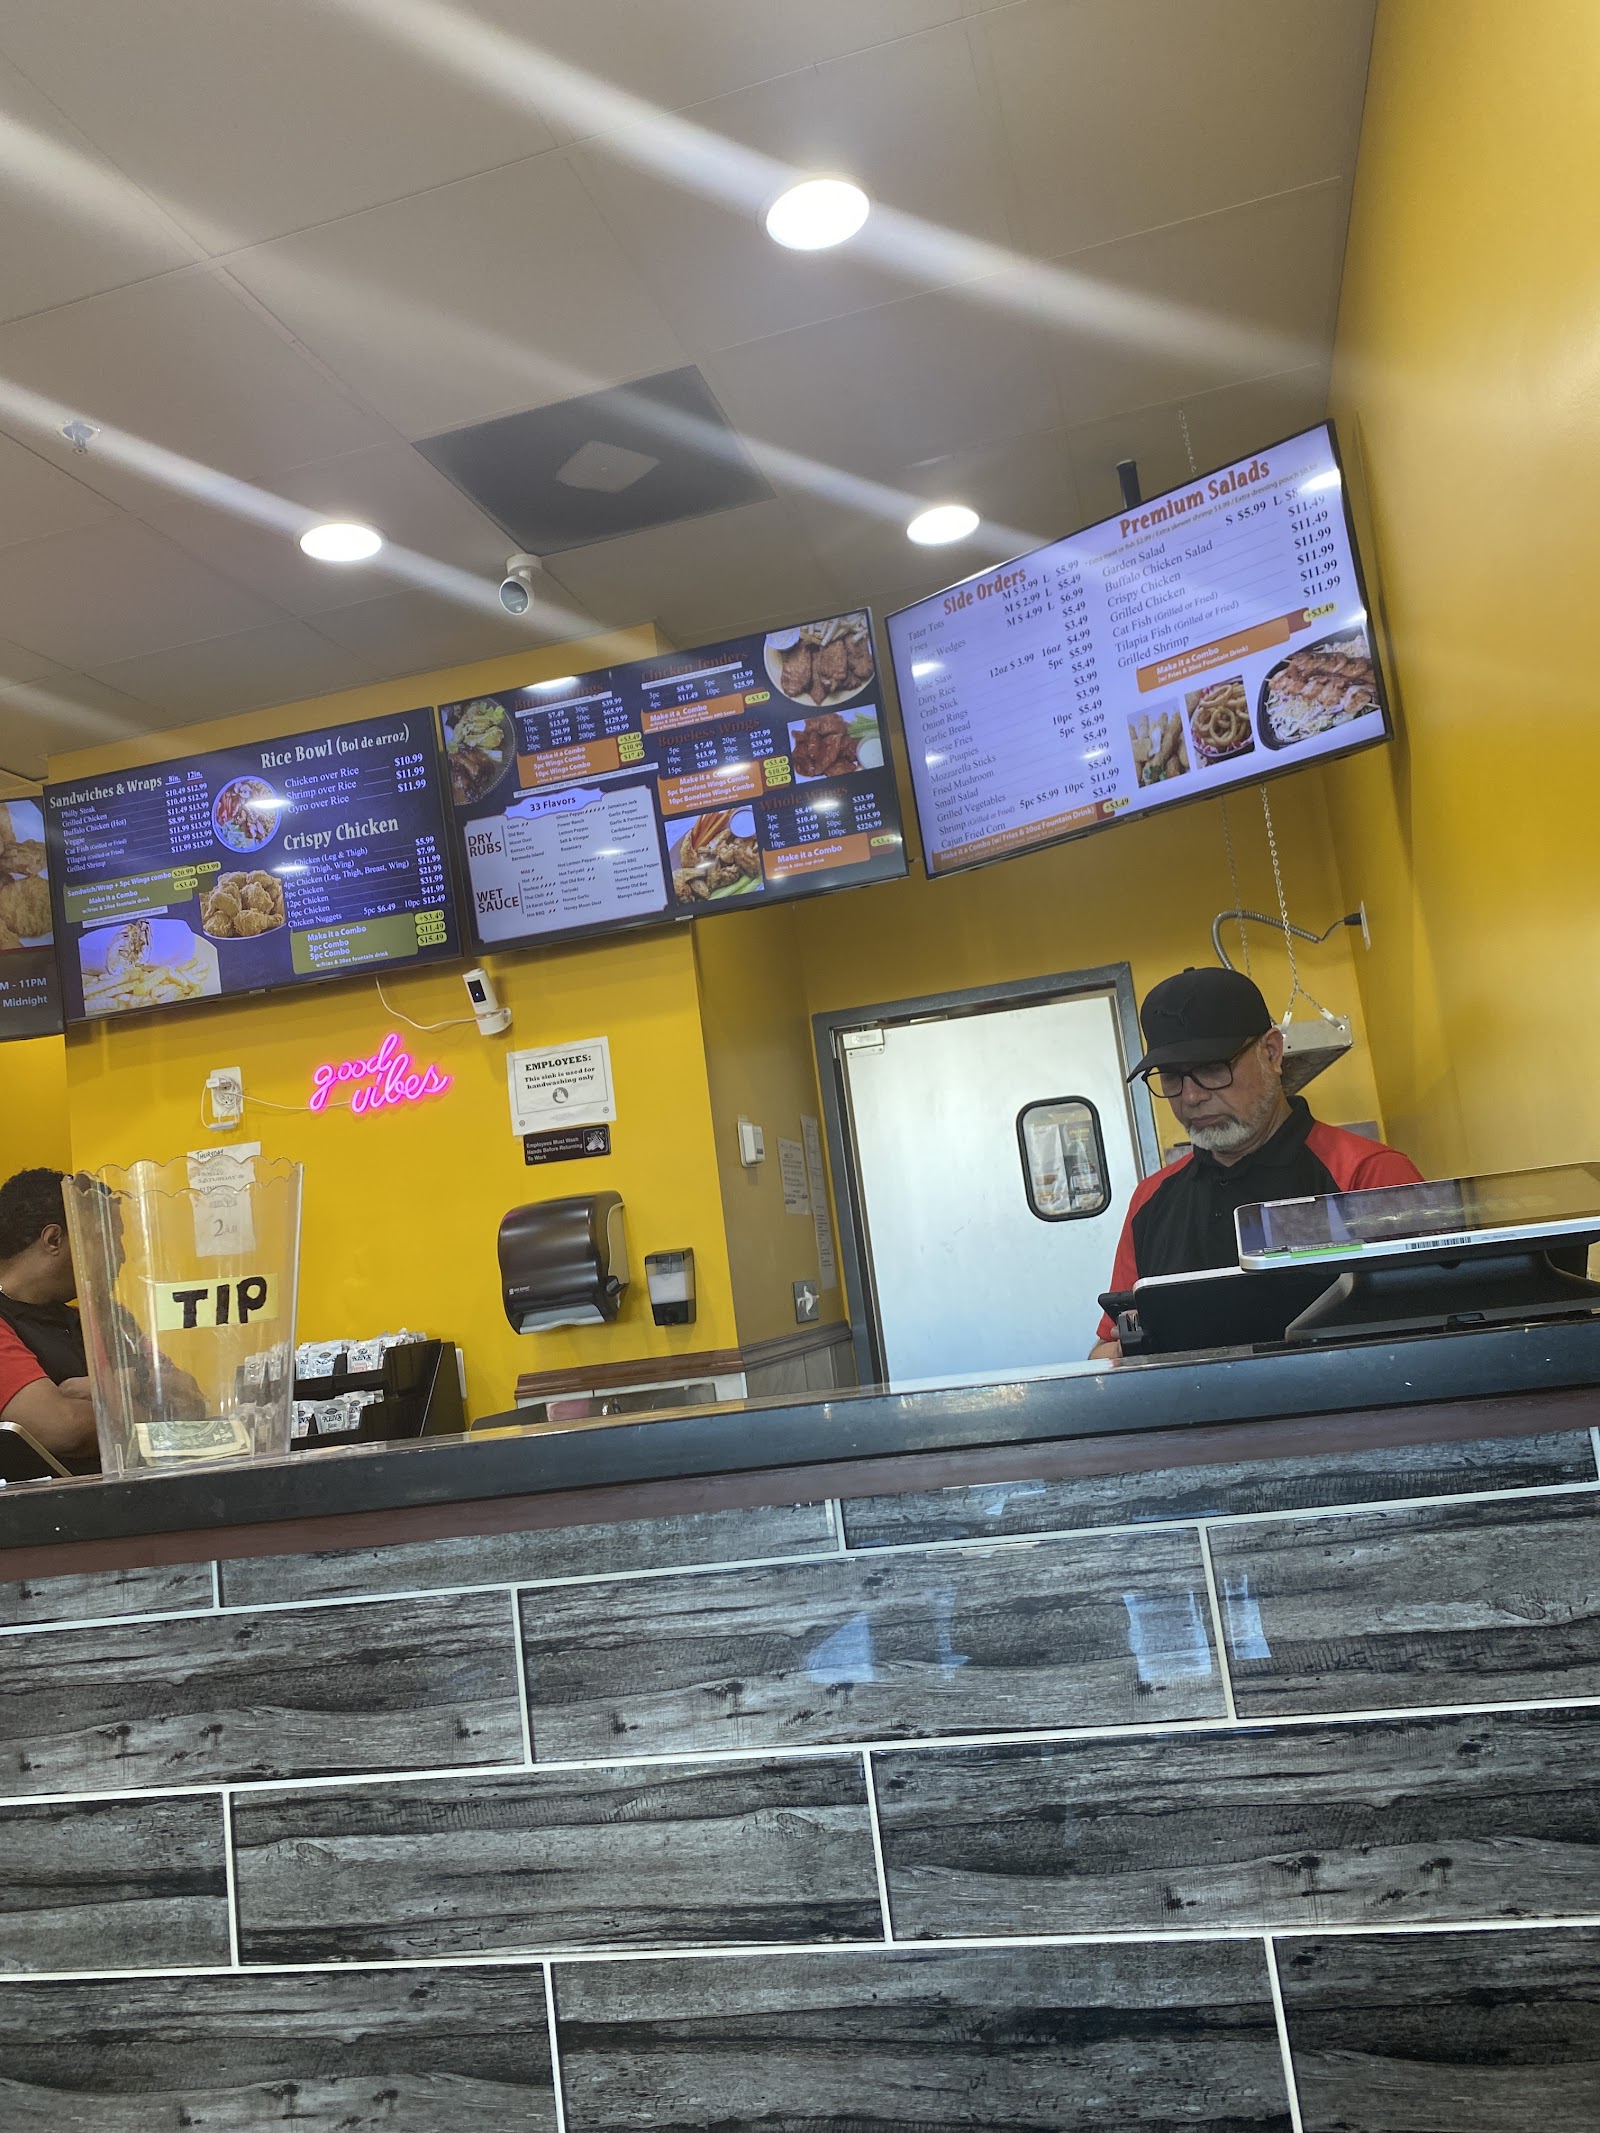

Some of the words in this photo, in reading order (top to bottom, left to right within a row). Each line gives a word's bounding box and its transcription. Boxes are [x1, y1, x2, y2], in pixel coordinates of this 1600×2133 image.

[1120, 490, 1204, 538] Premium
[1208, 459, 1270, 500] Salads
[1102, 558, 1136, 577] Garden
[1138, 543, 1165, 562] Salad
[1226, 515, 1232, 526] S
[1238, 501, 1266, 521] $5.99
[1105, 571, 1140, 592] Buffalo
[1143, 556, 1182, 576] Chicken
[1185, 540, 1212, 560] Salad
[1288, 496, 1324, 517] $11.49
[1108, 589, 1138, 607] Crispy
[1141, 572, 1180, 594] Chicken
[1292, 511, 1328, 533] $11.49
[1110, 602, 1142, 622] Grilled
[1146, 587, 1185, 608] Chicken
[1294, 527, 1331, 549] $11.99
[944, 591, 973, 616] Side
[976, 568, 1027, 601] Orders
[1112, 624, 1128, 638] Cat
[1132, 615, 1151, 631] Fish
[1298, 543, 1334, 565] $11.99
[1115, 636, 1148, 653] Tilapia
[1151, 624, 1171, 640] Fish
[1300, 559, 1337, 581] $11.99
[1118, 647, 1151, 668] Grilled
[1154, 636, 1189, 656] Shrimp
[1304, 576, 1340, 598] $11.99
[1307, 603, 1334, 617] +$3.49
[922, 716, 945, 732] Onion
[947, 709, 968, 724] Rings
[1072, 657, 1095, 673] $5.49
[924, 731, 946, 744] Garlic
[948, 721, 970, 736] Bread
[1074, 671, 1098, 687] $3.99
[261, 751, 292, 768] Rice
[295, 739, 332, 762] Bowl
[336, 736, 358, 755] (Bol
[361, 736, 373, 748] de
[376, 723, 409, 745] arroz)
[930, 764, 971, 784] Mozzarella
[973, 755, 996, 769] Sticks
[1060, 726, 1075, 738] 5pc
[1081, 713, 1104, 730] $6.99
[285, 774, 318, 788] Chicken
[320, 771, 338, 782] over
[340, 767, 359, 777] Rice
[395, 753, 422, 767] $10.99
[287, 787, 316, 801] Shrimp
[318, 785, 336, 795] over
[338, 781, 357, 791] Rice
[396, 766, 424, 779] $11.99
[50, 786, 113, 809] Sandwiches
[117, 784, 125, 795] &
[127, 777, 162, 792] Wraps
[168, 775, 180, 783] 8in.
[187, 771, 202, 779] 12in.
[80, 806, 96, 814] Steak
[166, 787, 185, 797] $10.49
[187, 783, 208, 793] $12.99
[288, 801, 308, 814] Gyro
[311, 799, 328, 809] over
[330, 794, 349, 805] Rice
[398, 779, 427, 793] $11.99
[530, 803, 541, 811] 33
[543, 797, 576, 809] Flavors
[853, 793, 874, 803] $33.99
[939, 821, 966, 835] Shrimp
[1020, 797, 1034, 809] 5pc
[1037, 789, 1059, 804] $5.99
[1064, 782, 1084, 795] 10pc
[1091, 768, 1119, 785] $11.99
[854, 803, 875, 813] $45.99
[856, 811, 881, 822] $115.99
[941, 837, 962, 849] Cajun
[965, 828, 984, 840] Fried
[986, 822, 1006, 834] Corn
[1093, 783, 1116, 799] $3.49
[284, 830, 332, 851] Crispy
[336, 818, 399, 841] Chicken
[468, 833, 492, 846] DRY
[857, 820, 882, 831] $226.99
[313, 863, 332, 874] Thigh,
[334, 859, 355, 869] Wing)
[417, 846, 435, 855] $7.99
[322, 853, 337, 862] (Leg
[346, 848, 368, 858] Thigh)
[415, 836, 434, 846] $5.99
[470, 842, 501, 857] RUBS
[777, 853, 799, 863] Make
[801, 851, 806, 859] it
[814, 845, 842, 856] Combo
[284, 881, 296, 889] 4pc
[298, 876, 322, 887] Chicken
[324, 871, 342, 883] (Leg,
[343, 868, 363, 878] Thigh,
[365, 864, 387, 874] Breast,
[389, 860, 409, 870] Wing)
[418, 855, 441, 865] $11.99
[285, 891, 296, 899] 8pc
[298, 886, 324, 897] Chicken
[419, 865, 442, 875] $21.99
[286, 900, 301, 909] 12pc
[302, 895, 329, 905] Chicken
[420, 875, 443, 884] $31.99
[287, 910, 302, 919] 16pc
[304, 904, 330, 915] Chicken
[421, 885, 444, 894] $41.99
[477, 889, 503, 902] WET
[479, 897, 520, 913] SAUCE
[288, 918, 314, 928] Chicken
[316, 913, 342, 924] Nuggets
[364, 908, 375, 916] 5pc
[377, 903, 396, 913] $6.49
[404, 899, 420, 908] 10pc
[422, 894, 446, 905] $12.49
[307, 932, 326, 941] Make
[328, 930, 334, 938] it
[341, 926, 367, 935] Combo
[418, 912, 443, 922] +$3.49
[19, 978, 47, 988] 11PM
[3, 996, 48, 1007] Midnight
[310, 1033, 398, 1110] good
[526, 1054, 591, 1071] EMPLOYEES:
[352, 1054, 449, 1112] vibes
[527, 1078, 577, 1090] handwashing
[526, 1141, 552, 1149] Employees
[172, 1276, 267, 1328] TIP
